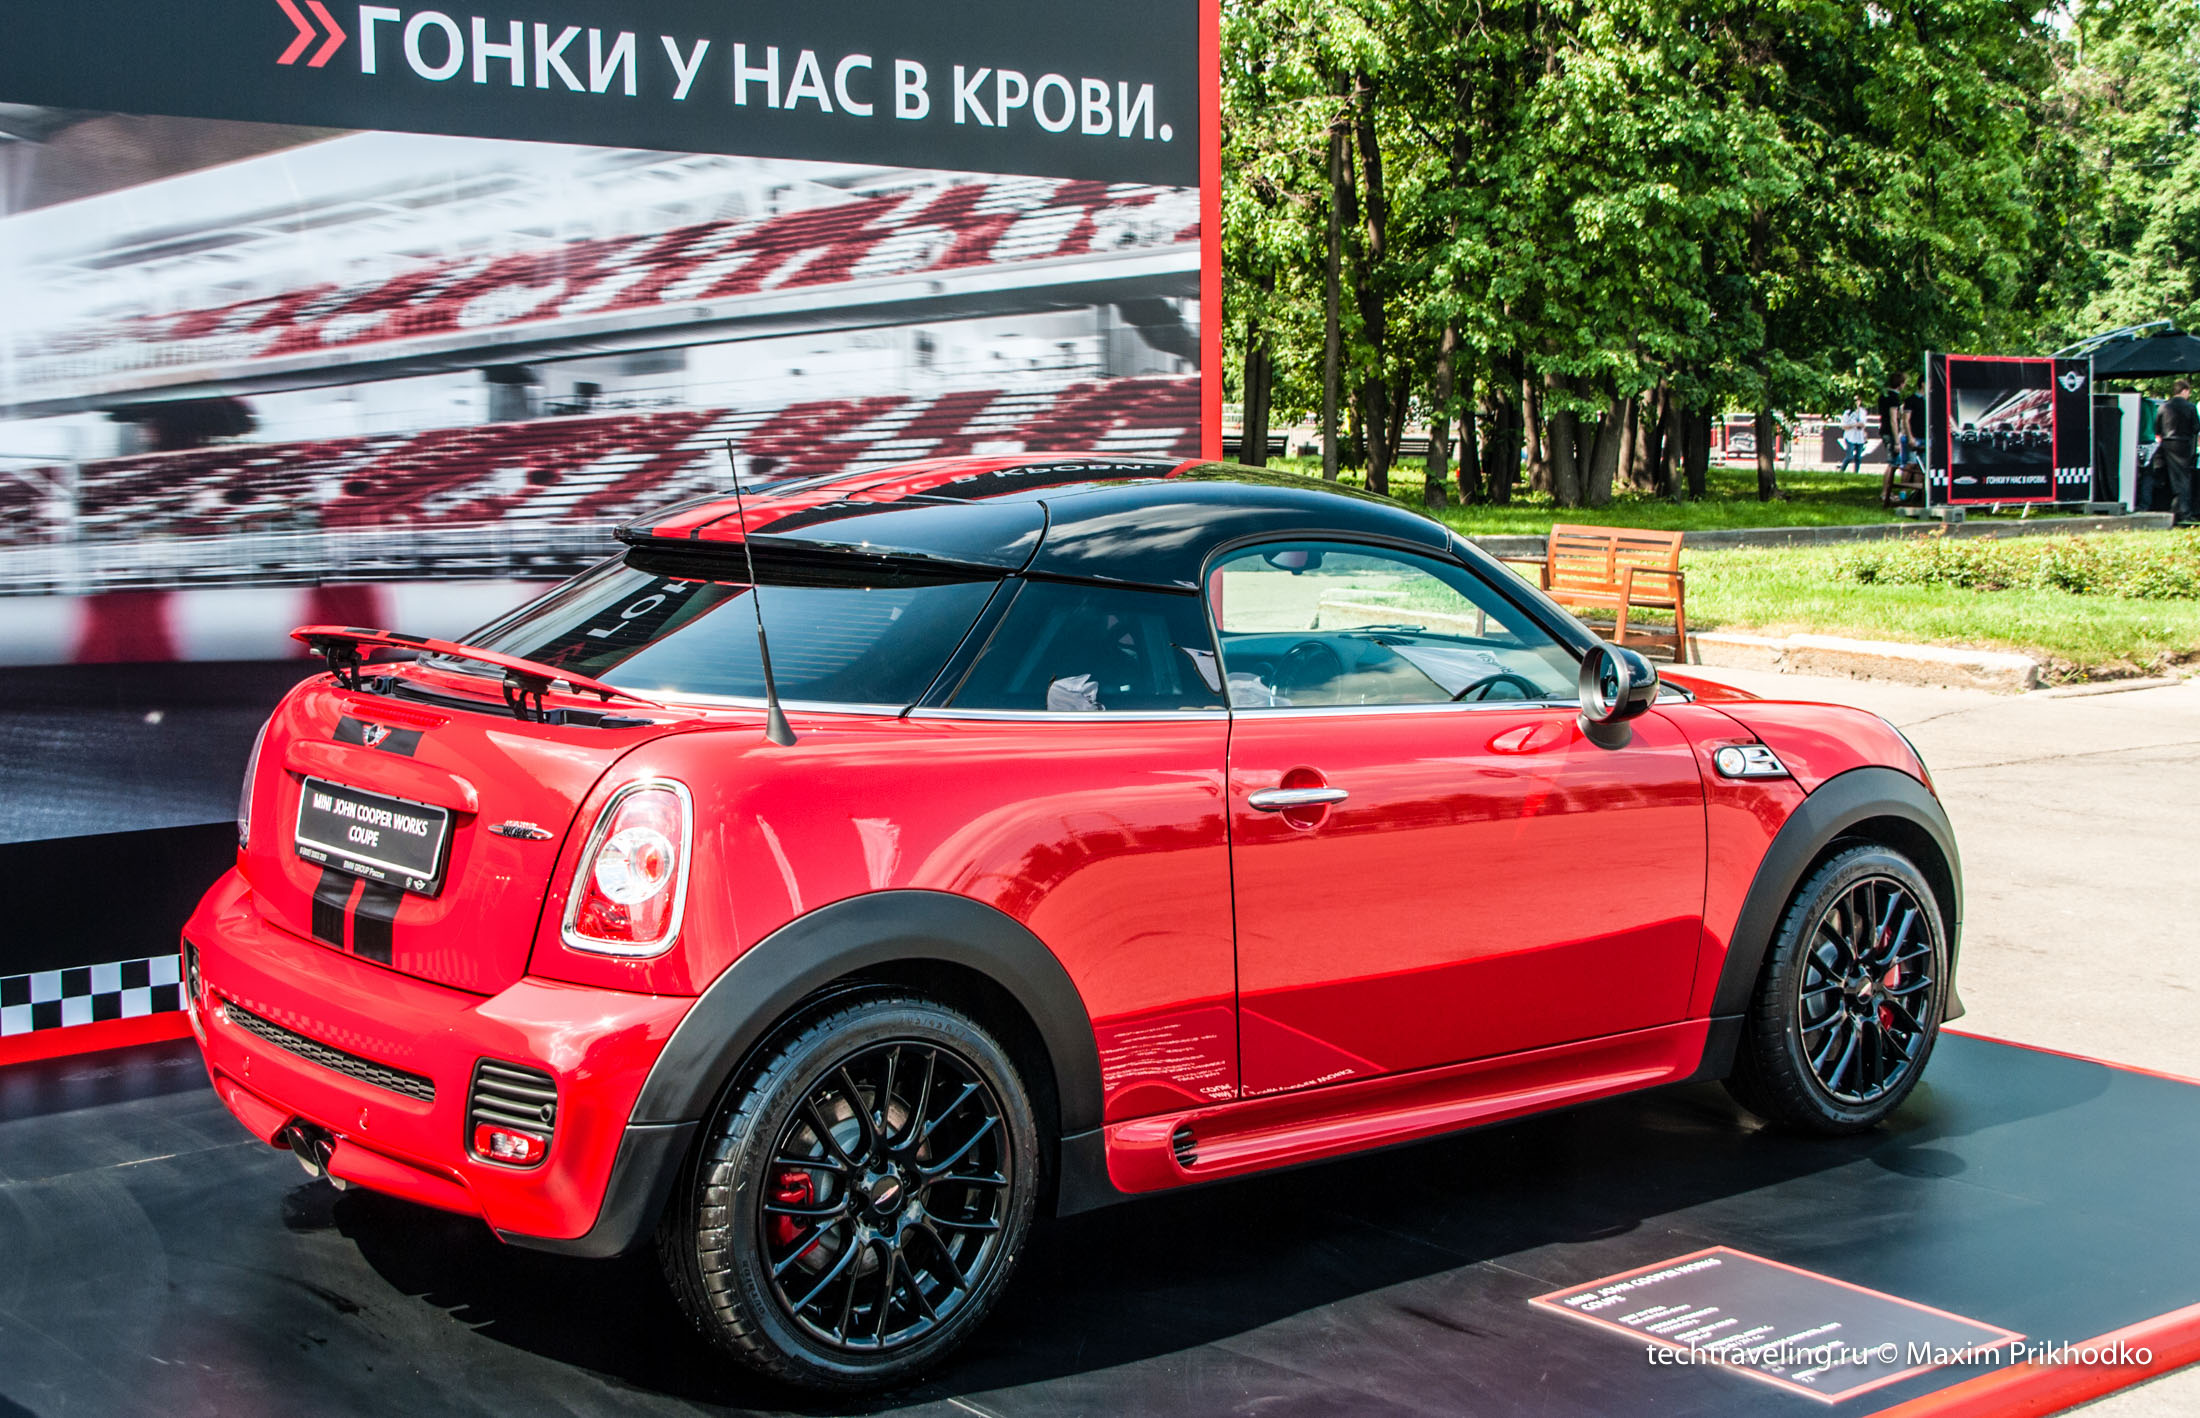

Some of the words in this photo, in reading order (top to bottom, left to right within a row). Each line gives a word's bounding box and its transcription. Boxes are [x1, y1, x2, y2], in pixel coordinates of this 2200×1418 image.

[359, 4, 637, 98] ГОНКИ
[660, 35, 711, 101] У
[733, 42, 874, 118] НАС
[894, 58, 930, 121] В
[953, 64, 1174, 143] КРОВИ.
[313, 792, 332, 812] MINI
[333, 799, 358, 819] JOHN
[357, 804, 393, 829] COOPER
[393, 813, 429, 837] WORKS
[348, 825, 380, 847] COUPE
